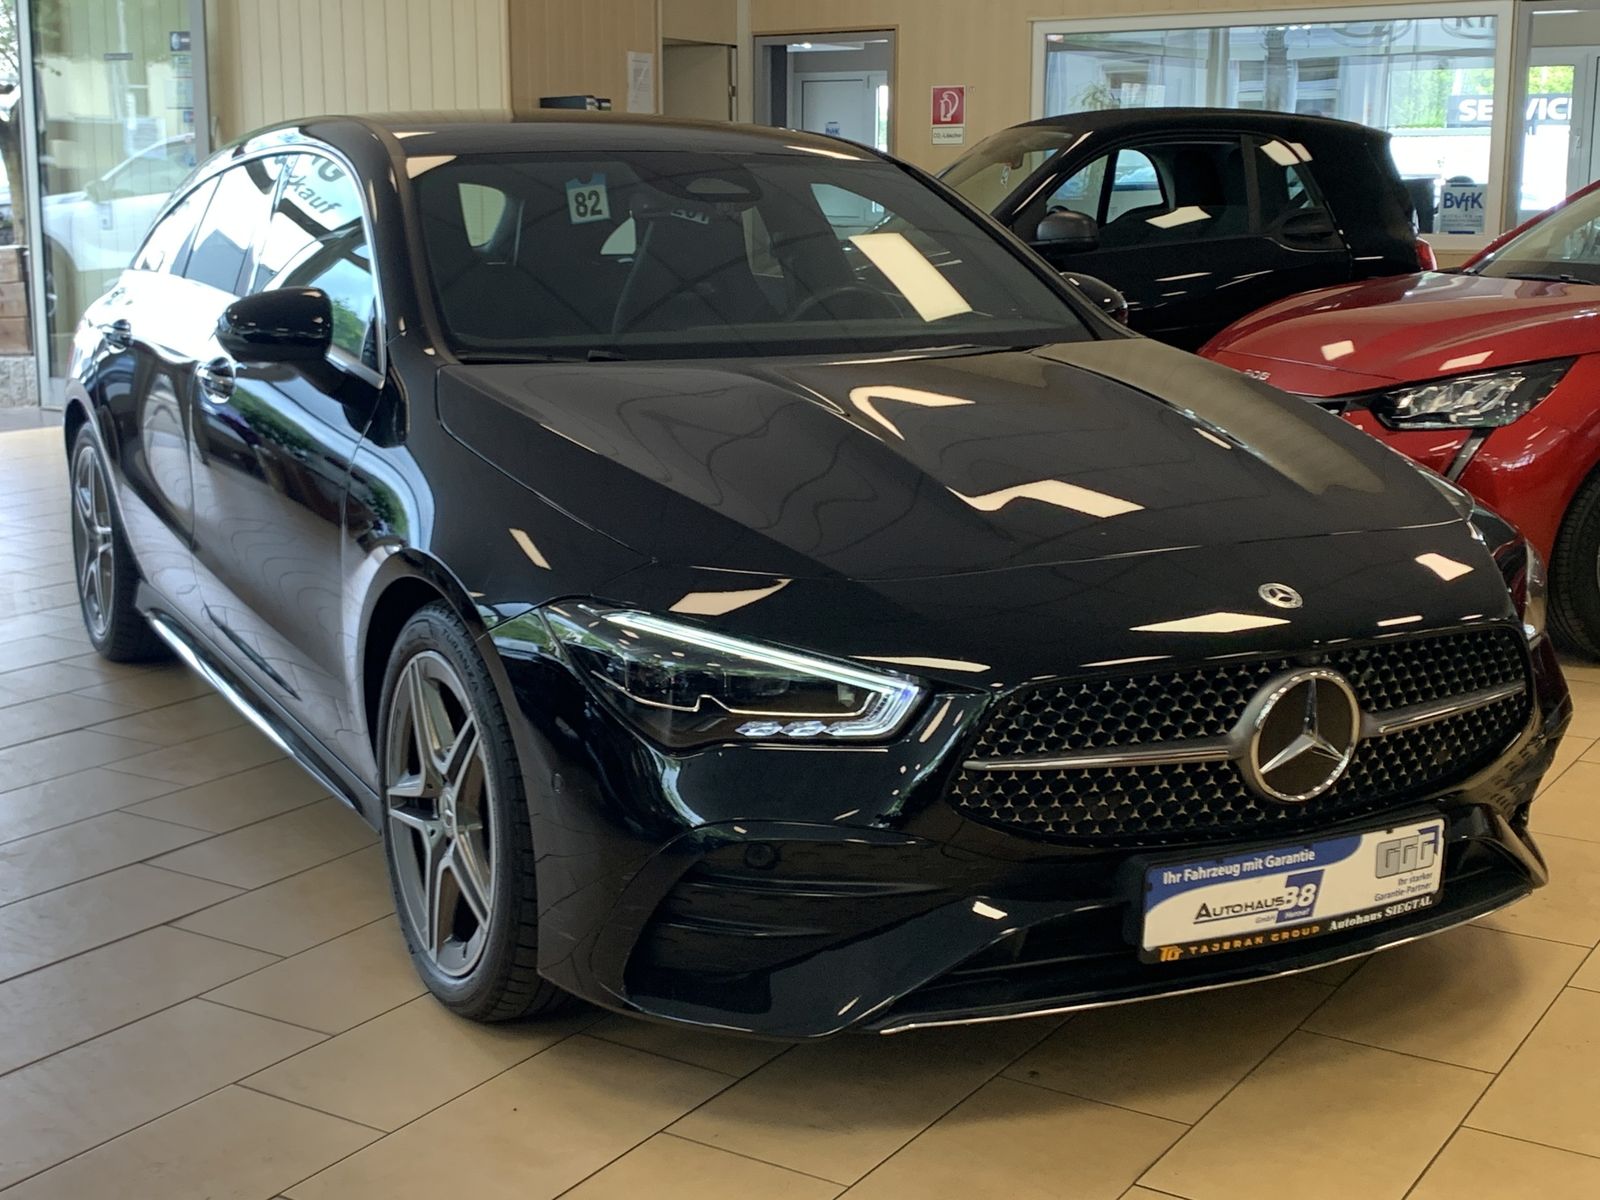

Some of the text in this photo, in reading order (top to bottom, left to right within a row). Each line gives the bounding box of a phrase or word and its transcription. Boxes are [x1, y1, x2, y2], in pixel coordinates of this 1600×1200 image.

[1458, 97, 1573, 122] SEVIC
[574, 190, 603, 218] 82
[1443, 192, 1483, 212] BvfK
[1163, 848, 1316, 885] Ihr Fahrzeug mit Garantie
[1328, 895, 1433, 931] Autohaus SIEGTAL
[1270, 925, 1321, 942] GROUP
